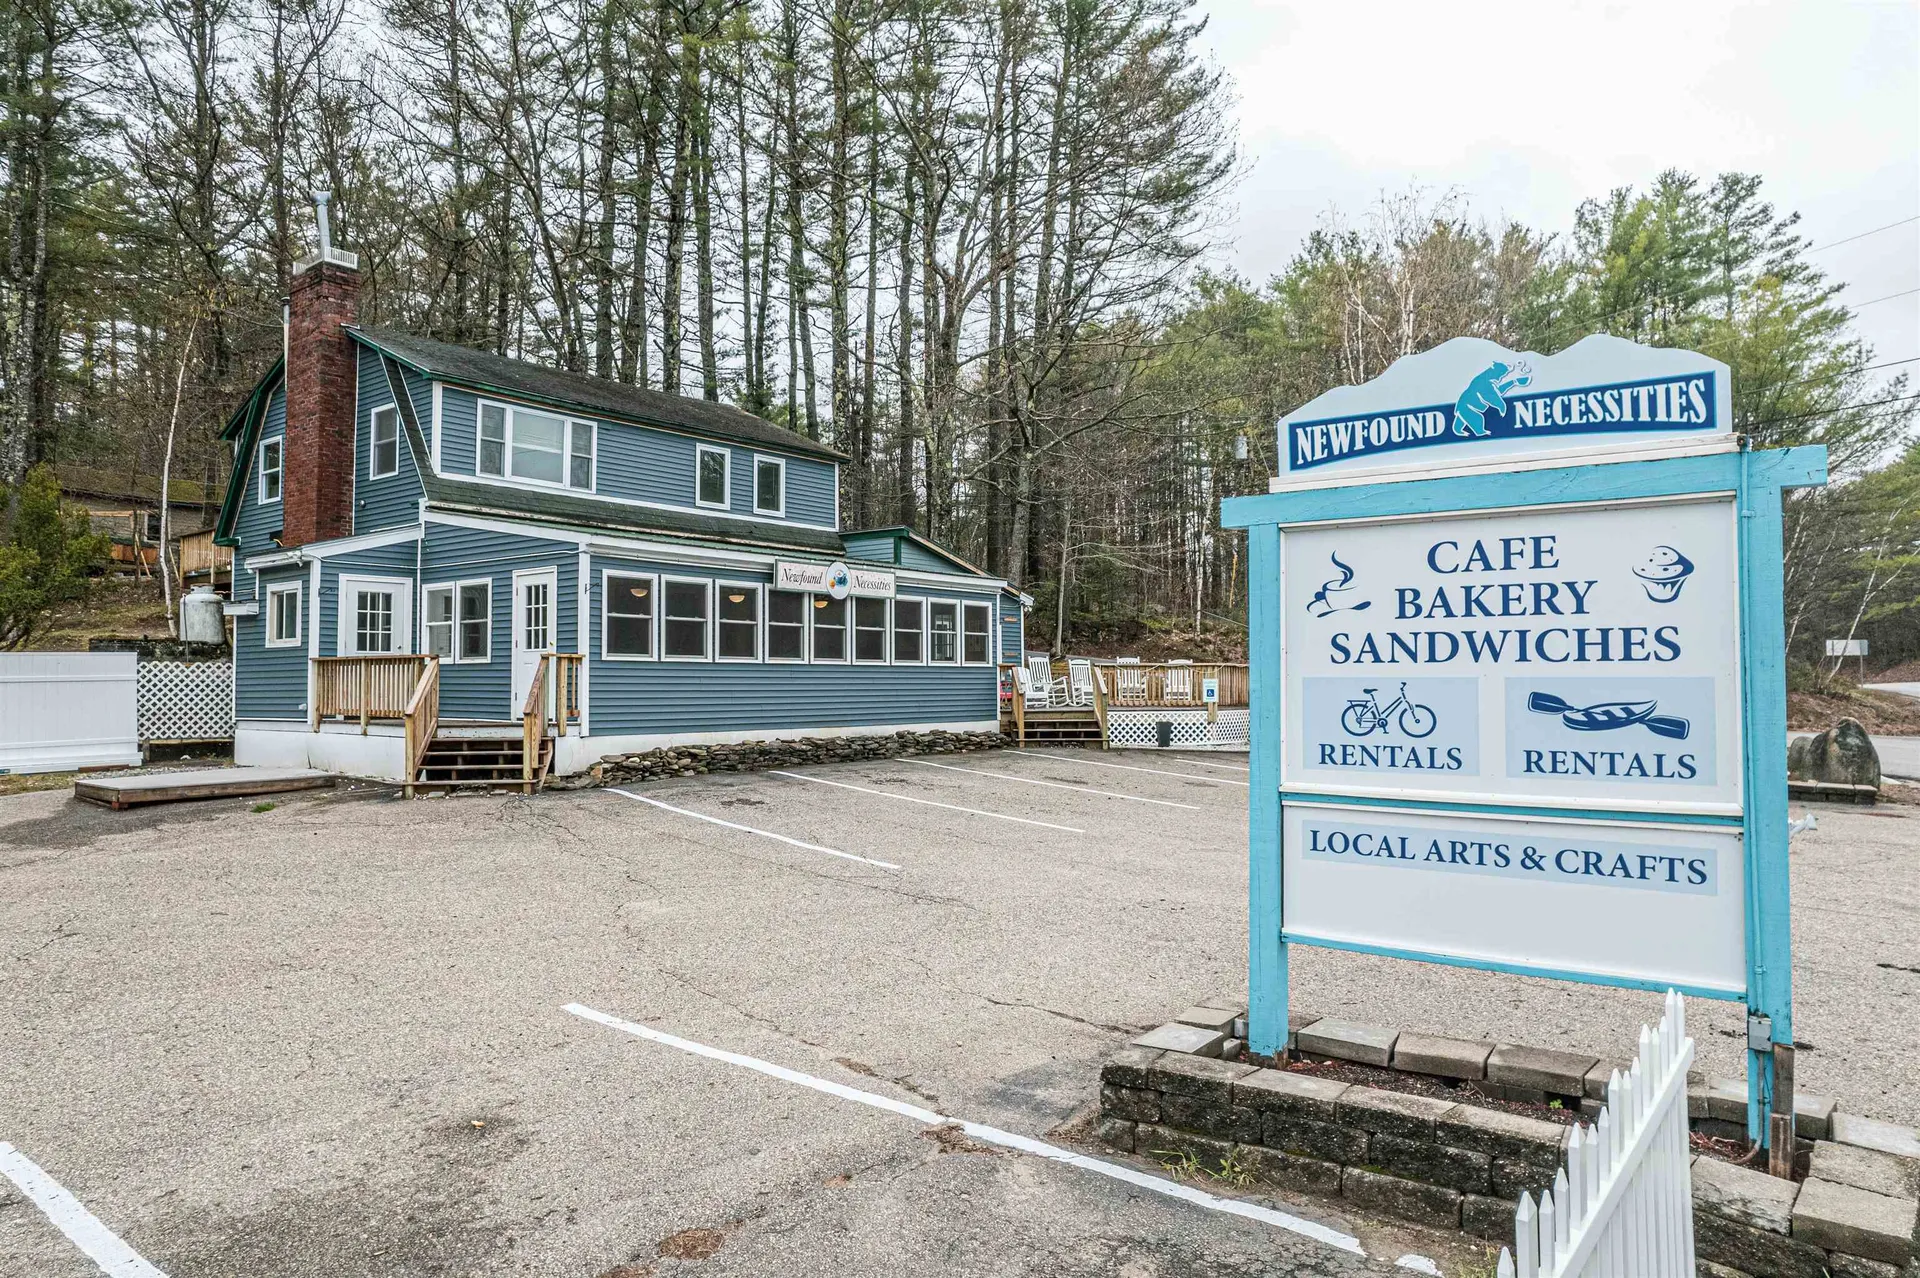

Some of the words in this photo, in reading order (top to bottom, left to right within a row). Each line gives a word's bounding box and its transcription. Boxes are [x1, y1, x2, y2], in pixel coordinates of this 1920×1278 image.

[1296, 411, 1446, 465] NEWFOUND
[1514, 379, 1707, 429] NECESSITIES
[1426, 535, 1560, 574] CAFE
[781, 568, 823, 586] Newfound
[853, 575, 891, 591] Necessities
[1394, 580, 1598, 620] BAKERY
[1330, 625, 1682, 664] SANDWICHES
[1318, 743, 1463, 771] RENTALS
[1523, 749, 1698, 780] RENTALS
[1309, 829, 1417, 861] LOCAL
[1423, 839, 1511, 869] ARTS
[1520, 846, 1548, 871] &
[1555, 848, 1708, 886] CRAFTS
